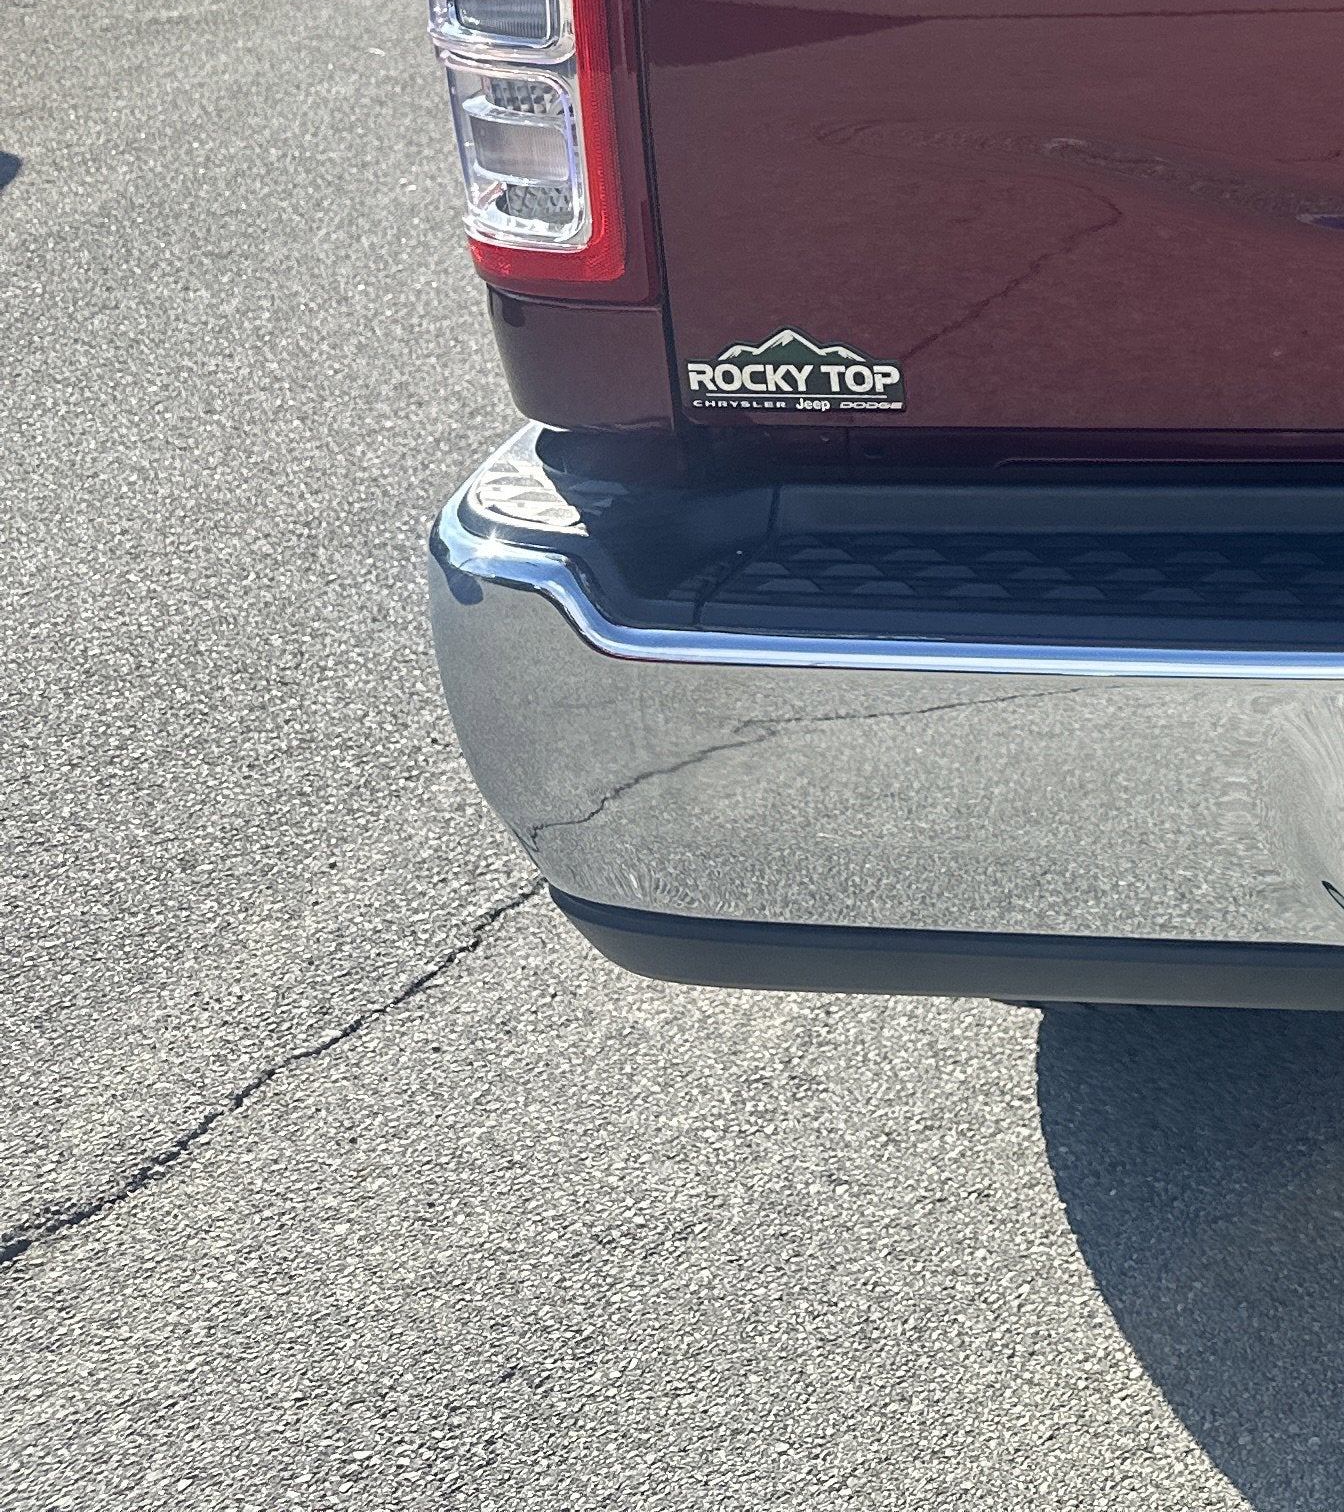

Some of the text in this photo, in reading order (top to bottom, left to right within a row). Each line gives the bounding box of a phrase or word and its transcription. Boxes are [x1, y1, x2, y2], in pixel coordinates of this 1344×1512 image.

[687, 363, 901, 393] ROCKY TOP
[692, 398, 903, 412] CHRYSLER Jeep DODGE
